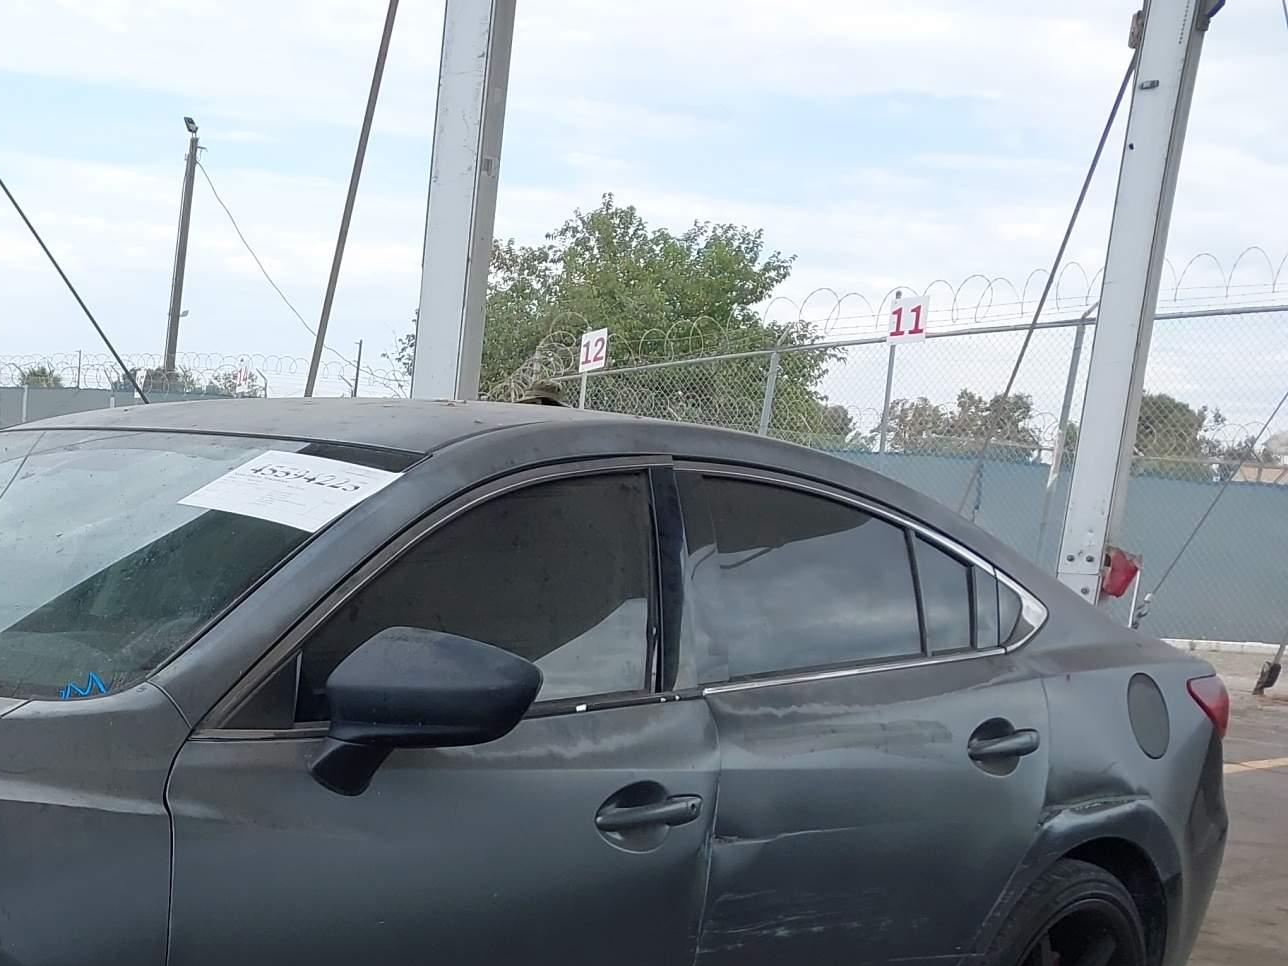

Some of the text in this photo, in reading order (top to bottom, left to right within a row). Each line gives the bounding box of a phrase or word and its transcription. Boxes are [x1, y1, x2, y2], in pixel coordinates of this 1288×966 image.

[889, 305, 924, 337] 11
[581, 336, 605, 365] 12
[250, 463, 361, 492] 45594225
